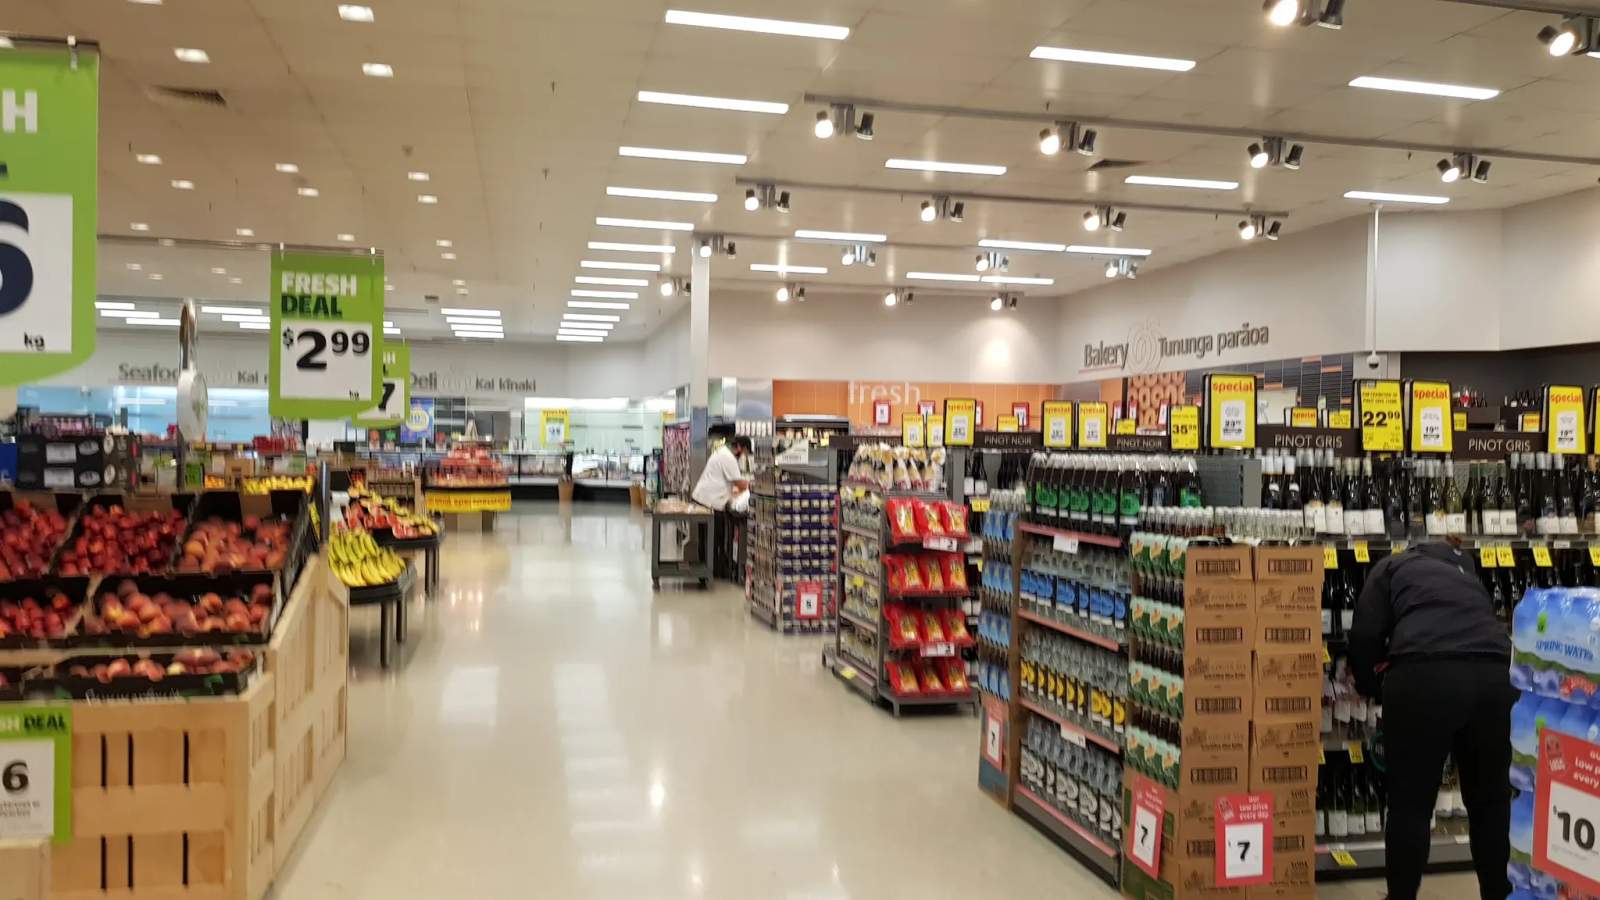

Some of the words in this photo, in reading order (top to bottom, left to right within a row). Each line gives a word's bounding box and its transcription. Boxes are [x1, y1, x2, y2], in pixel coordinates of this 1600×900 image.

[281, 271, 357, 295] FRESH
[280, 294, 343, 318] DEAL
[23, 331, 46, 352] kg
[1158, 335, 1213, 358] Tununga
[1083, 341, 1129, 369] Bakery
[847, 379, 921, 405] fresh
[1212, 381, 1254, 394] special
[1414, 388, 1449, 400] special
[1274, 435, 1311, 448] PINOT
[1315, 435, 1344, 449] GRIS
[1468, 438, 1502, 451] PINOT
[1505, 439, 1531, 452] GRIS
[1535, 640, 1563, 654] SPRING
[23, 714, 66, 730] DEAL
[1575, 756, 1593, 771] low
[2, 760, 29, 791] 6
[1140, 825, 1149, 846] 7
[1237, 841, 1251, 861] 7
